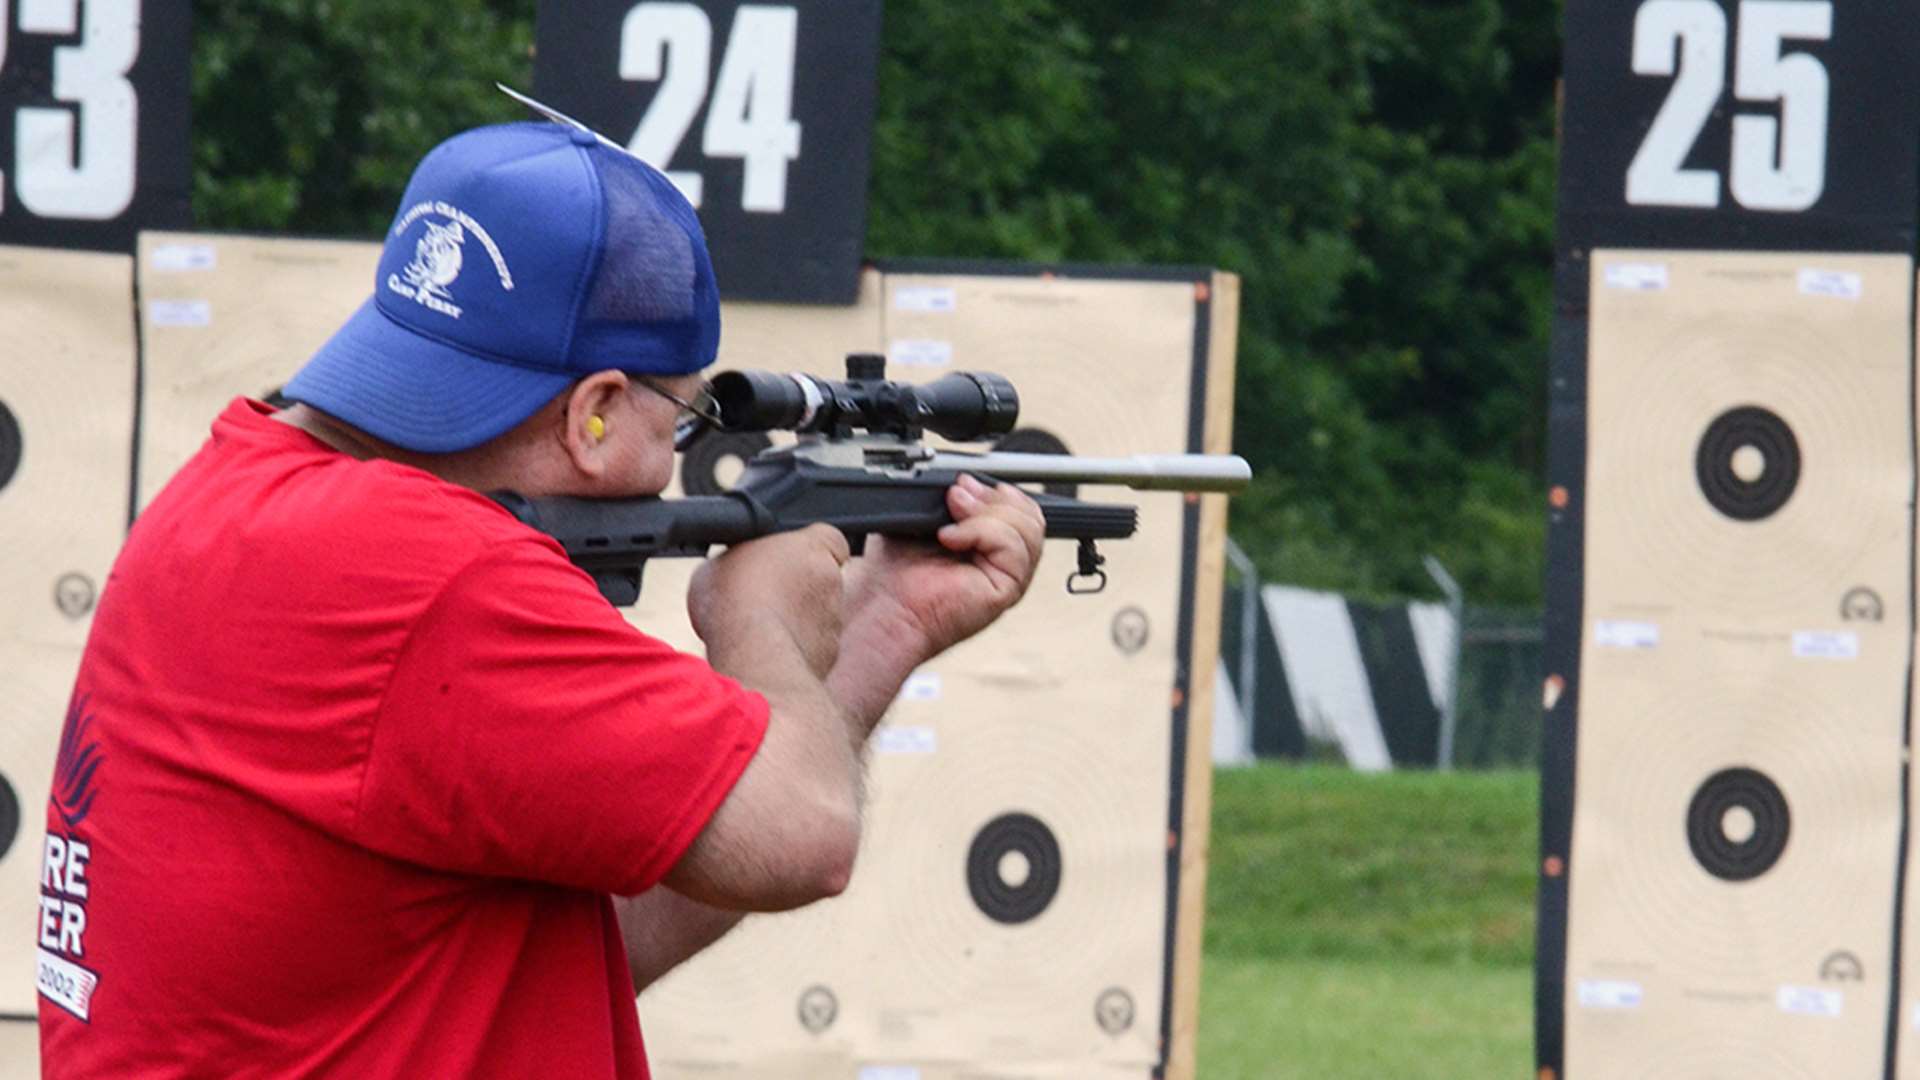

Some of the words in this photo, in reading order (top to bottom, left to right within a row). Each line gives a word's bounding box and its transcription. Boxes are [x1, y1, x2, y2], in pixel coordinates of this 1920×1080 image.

[0, 0, 141, 220] 3
[618, 1, 802, 214] 24
[1625, 0, 1833, 212] 25
